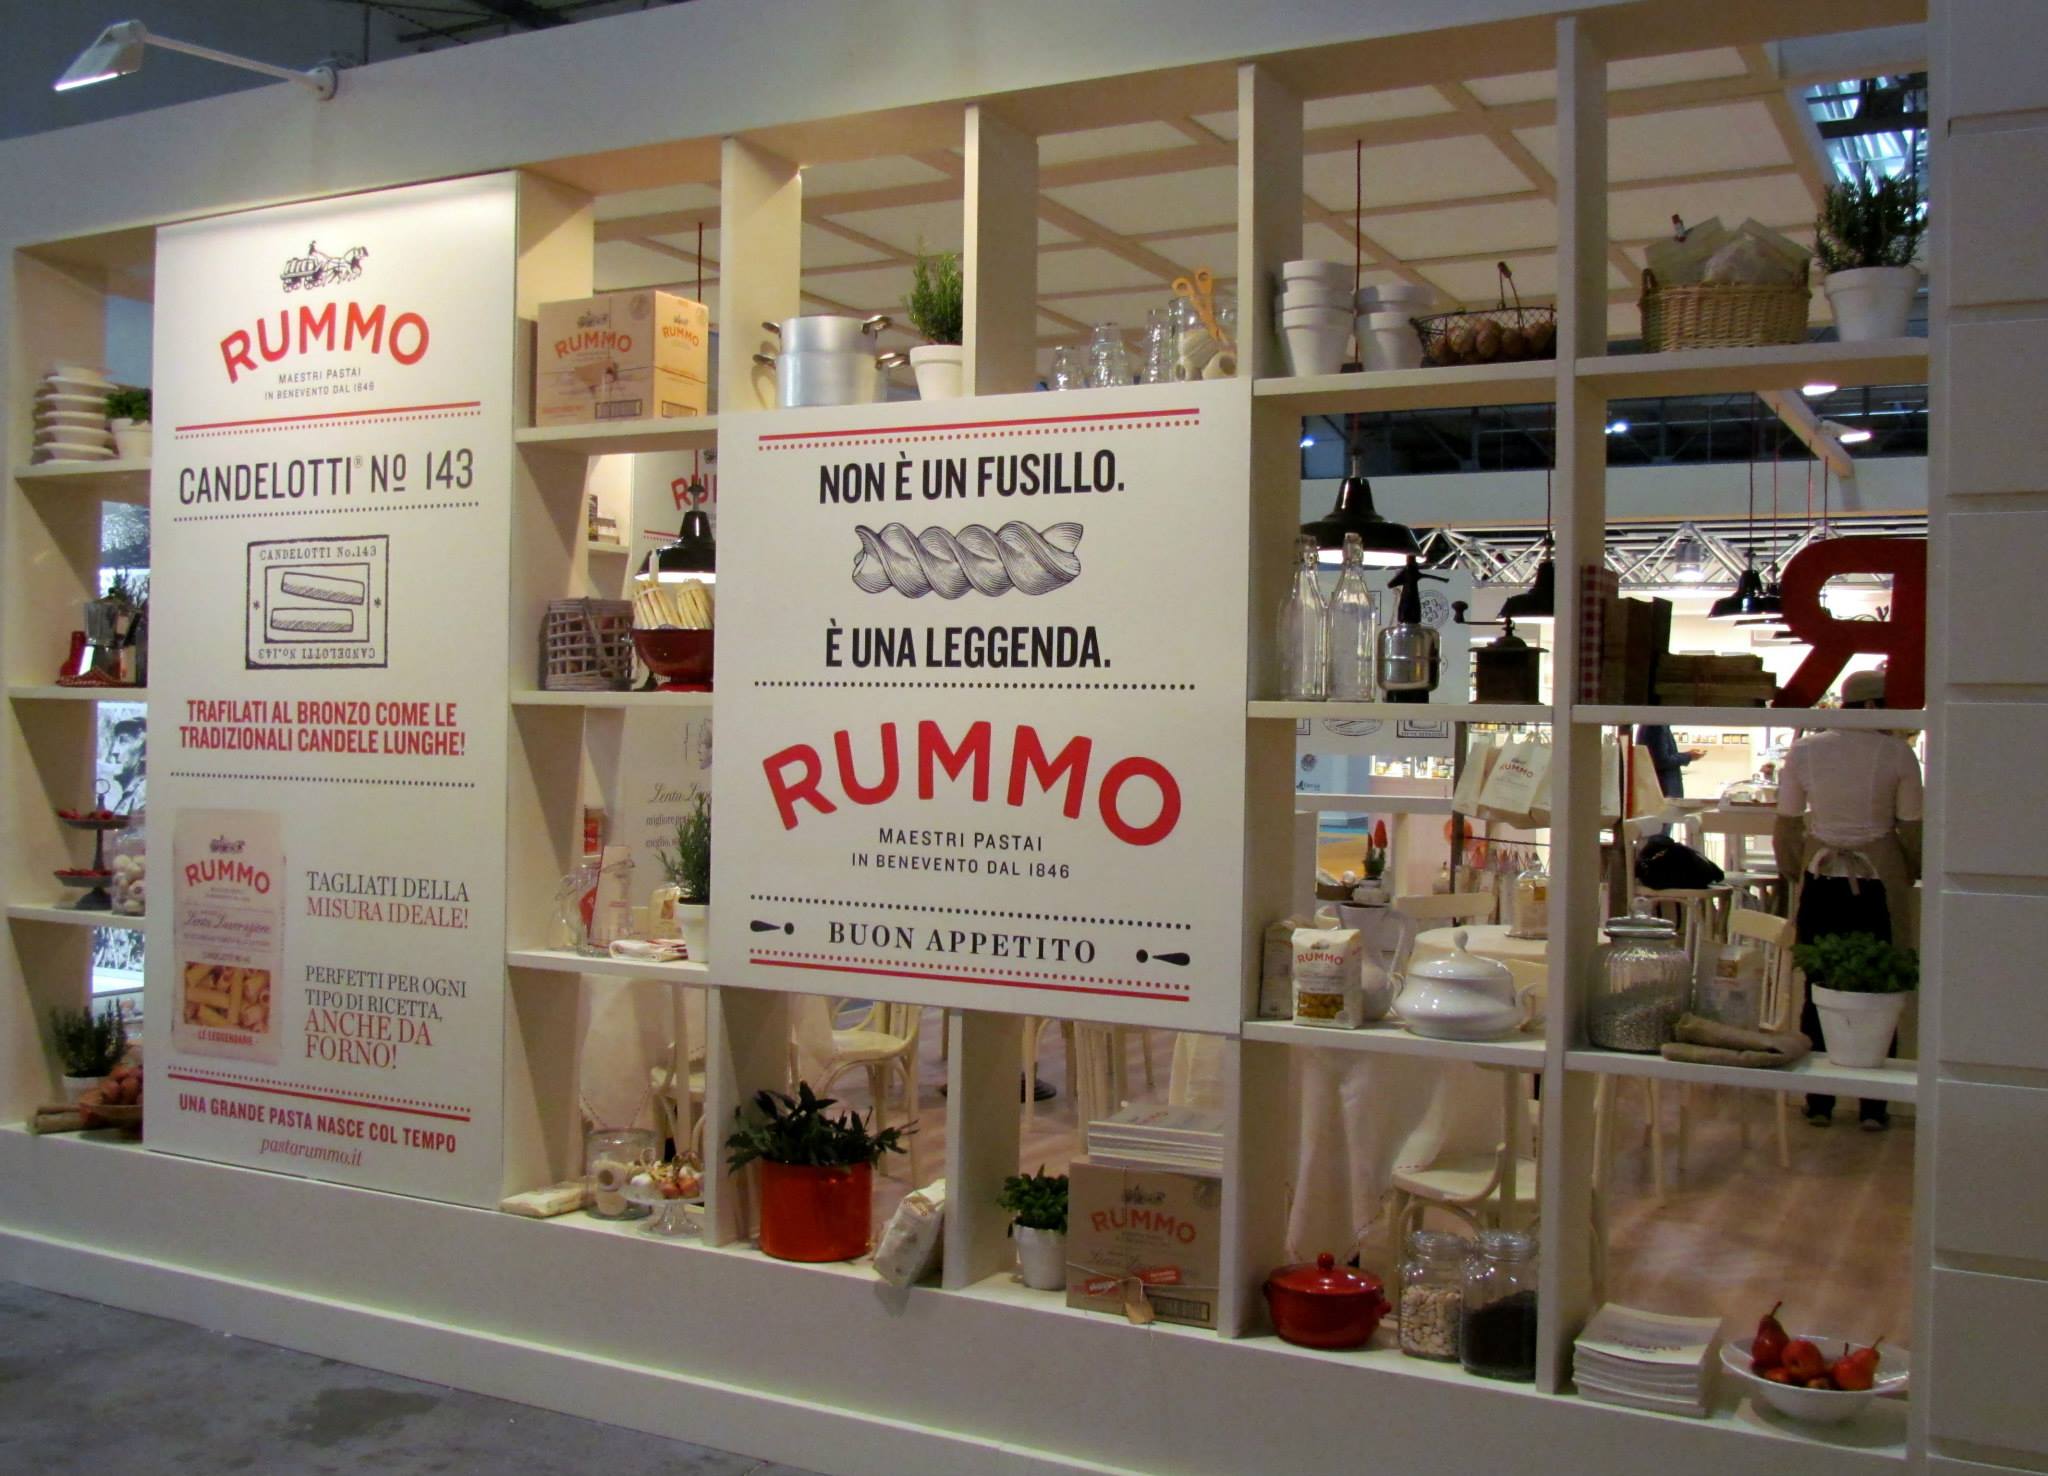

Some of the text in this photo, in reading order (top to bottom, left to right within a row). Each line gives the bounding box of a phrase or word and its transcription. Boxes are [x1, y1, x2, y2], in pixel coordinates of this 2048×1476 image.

[220, 302, 430, 384] RUMMO
[554, 330, 633, 358] RUMMO
[662, 325, 699, 347] RUMMO
[279, 367, 361, 385] MAESTRI PASTAI
[264, 391, 274, 401] IN
[277, 386, 329, 400] BENEVENTO
[332, 384, 350, 395] DAL
[426, 448, 474, 490] 143
[819, 449, 1125, 504] NON È UN FUSILLO.
[259, 547, 332, 561] CANDELOTTI
[825, 618, 1111, 668] È UNA LEGGENDA.
[187, 700, 457, 727] TRAFILATI AL BRONZO COME LE
[179, 726, 465, 756] TRADIZIONALI CANDELE LUNGHE!
[763, 720, 1181, 846] RUMMO
[879, 827, 1043, 852] MAESTRI PASTAI
[185, 859, 271, 894] RUMMO
[852, 852, 1071, 880] IN BENEVENTO DAL 1846
[306, 871, 470, 902] TAGLIATI DELLA
[306, 897, 469, 929] MISURA IDEALE!
[828, 920, 1097, 965] BUON APPETITO
[1297, 951, 1344, 966] RUMMO
[305, 965, 467, 999] PERFETTI PER OGNI
[305, 989, 443, 1022] TIPO DI RICETTA,
[304, 1008, 433, 1046] ANCHE DA
[305, 1034, 398, 1069] FORNO!
[179, 1093, 456, 1153] UNA GRANDE PASTA NASCE COL TEMPO
[259, 1136, 363, 1168] pastarummo.it
[1090, 1207, 1197, 1244] RUMMO
